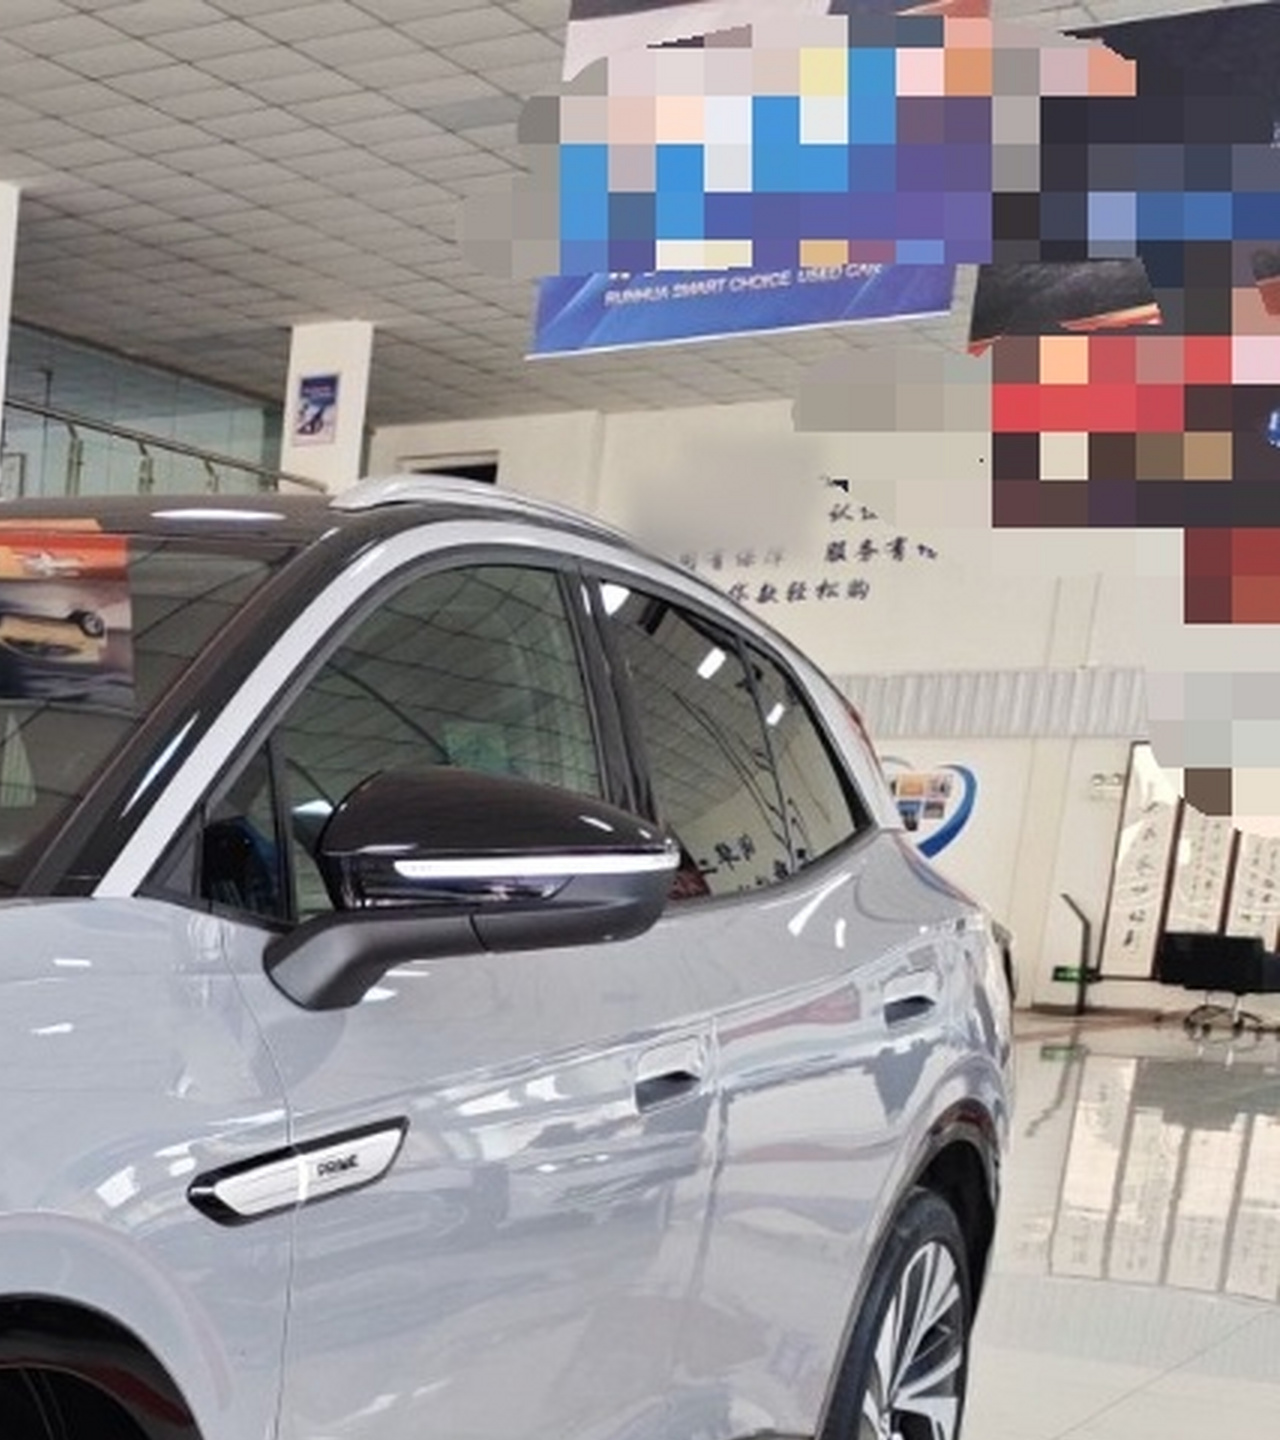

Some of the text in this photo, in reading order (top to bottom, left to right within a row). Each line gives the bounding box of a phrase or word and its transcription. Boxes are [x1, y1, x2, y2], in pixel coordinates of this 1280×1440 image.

[604, 287, 669, 307] RUNHUA
[671, 277, 726, 300] SMART
[729, 270, 791, 293] CHOICE
